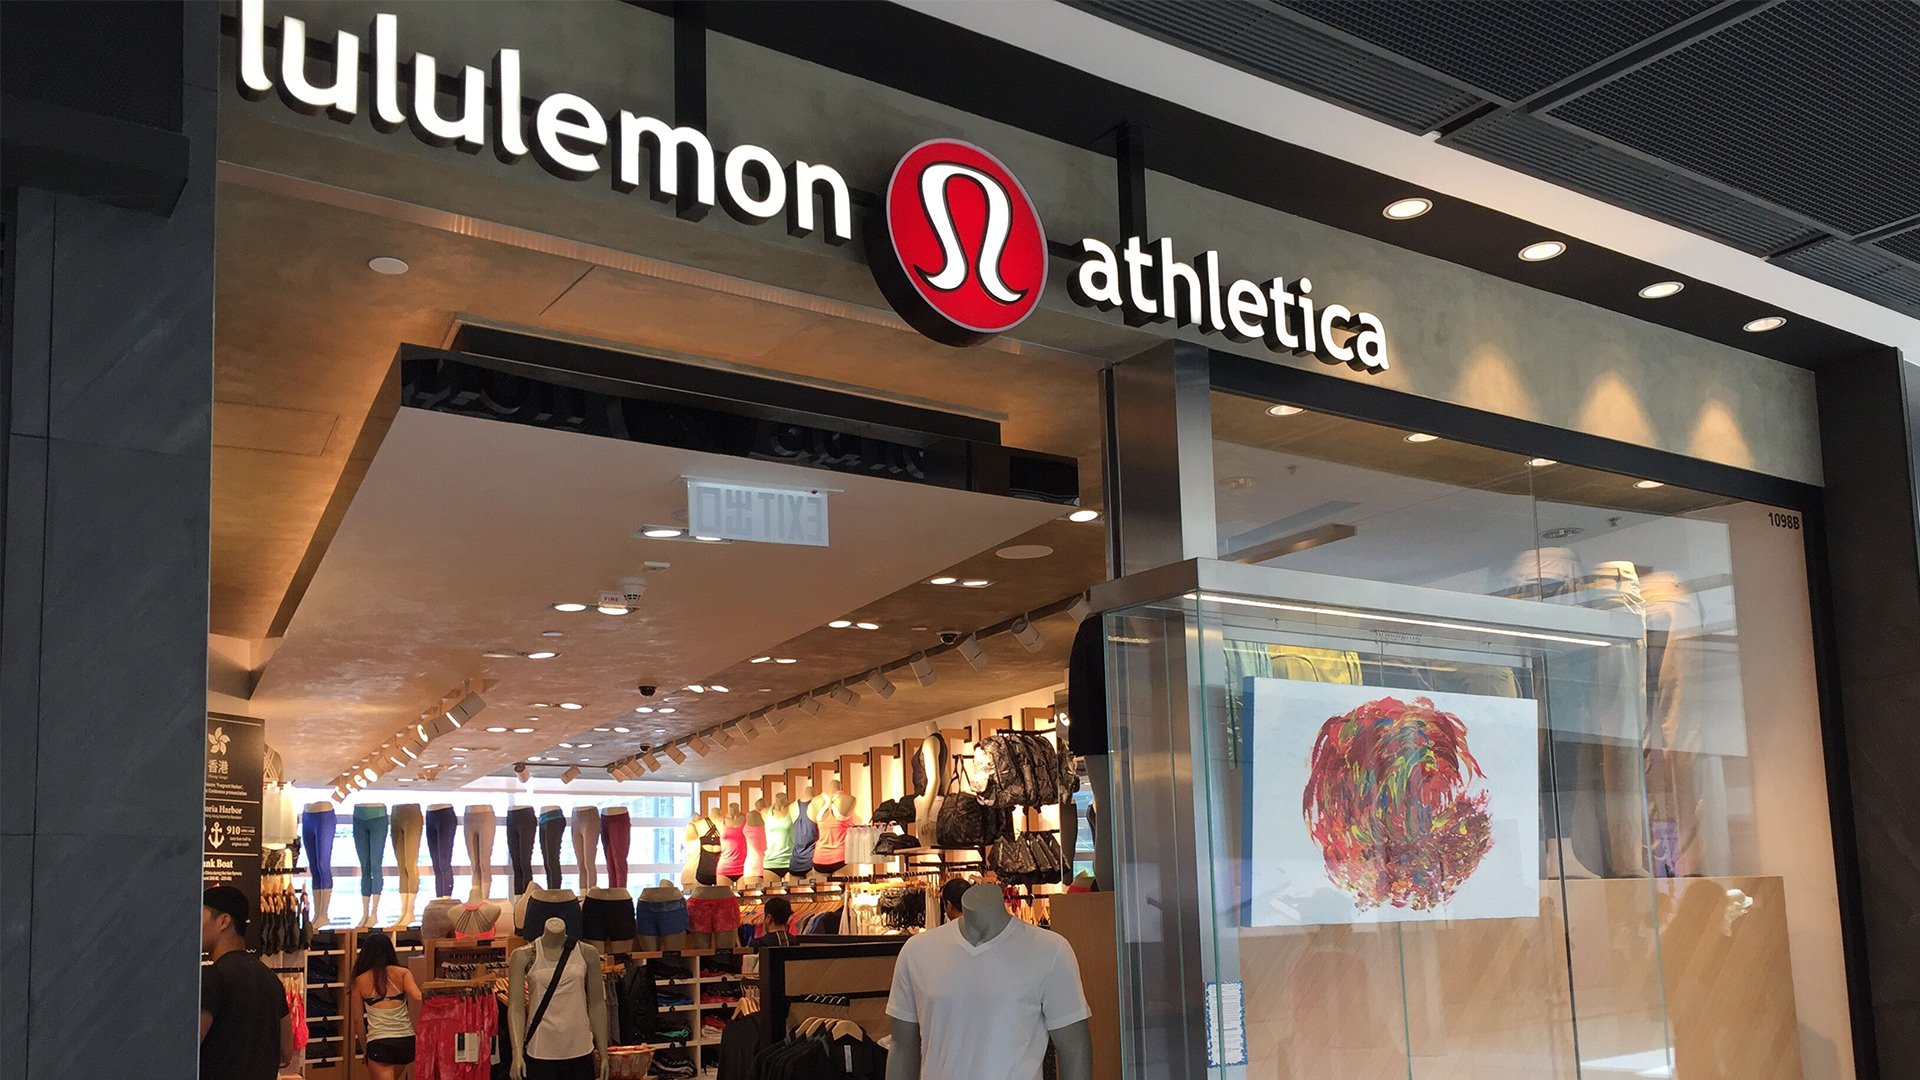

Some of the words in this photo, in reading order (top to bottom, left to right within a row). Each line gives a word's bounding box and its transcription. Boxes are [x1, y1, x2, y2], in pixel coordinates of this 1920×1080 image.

[242, 0, 851, 239] lululemon
[1080, 237, 1390, 369] athletica
[1768, 512, 1800, 530] 1098B
[207, 759, 229, 774] 香港
[219, 805, 242, 814] Harbor
[226, 825, 241, 835] 910
[216, 859, 233, 868] Boat
